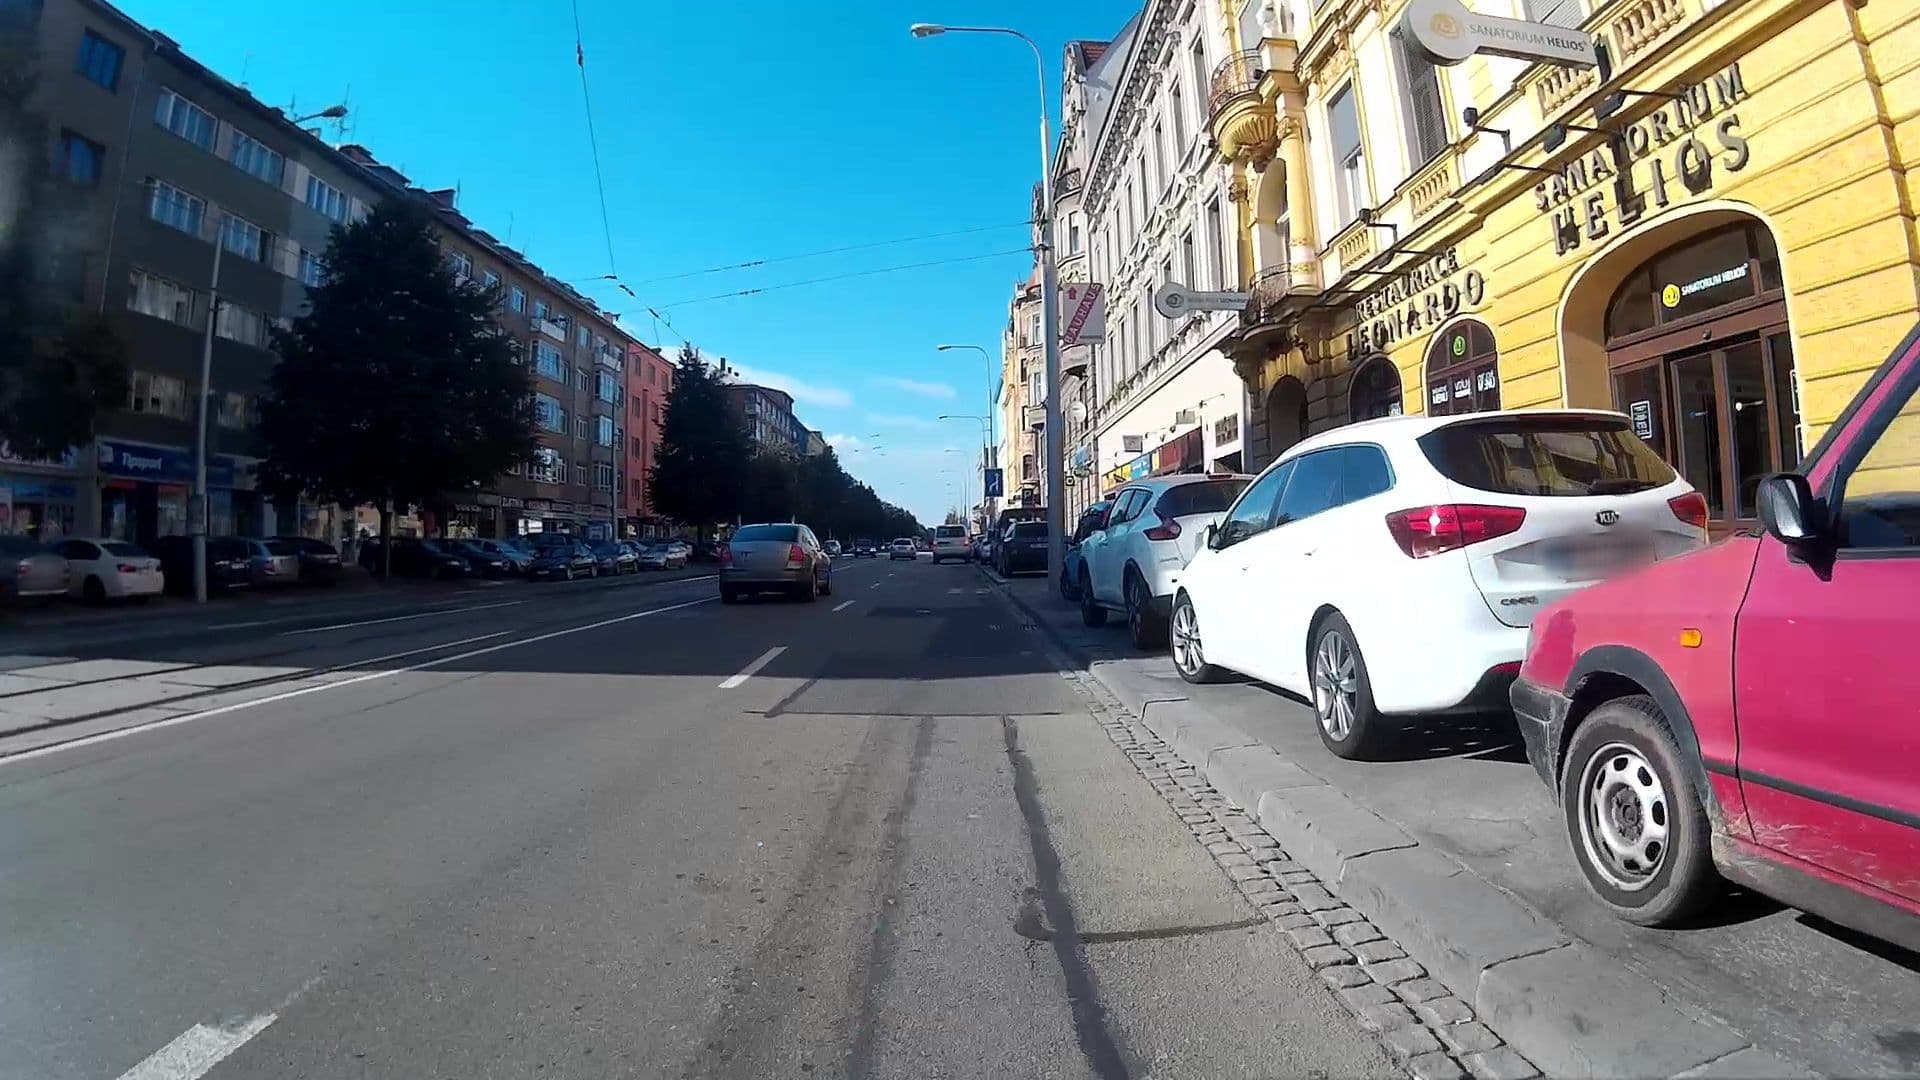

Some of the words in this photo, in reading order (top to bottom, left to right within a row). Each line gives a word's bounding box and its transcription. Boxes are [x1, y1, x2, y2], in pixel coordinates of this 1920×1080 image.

[1470, 24, 1545, 44] SANATORIUM
[1535, 63, 1748, 211] SANATORIUM
[1552, 113, 1749, 256] HELIOS
[1064, 283, 1100, 344] BAUHAUS
[1346, 270, 1484, 360] LEONARDO
[1356, 247, 1459, 322] RESTAURACE
[1681, 273, 1721, 296] SANATORIUM
[1599, 512, 1618, 525] KIA
